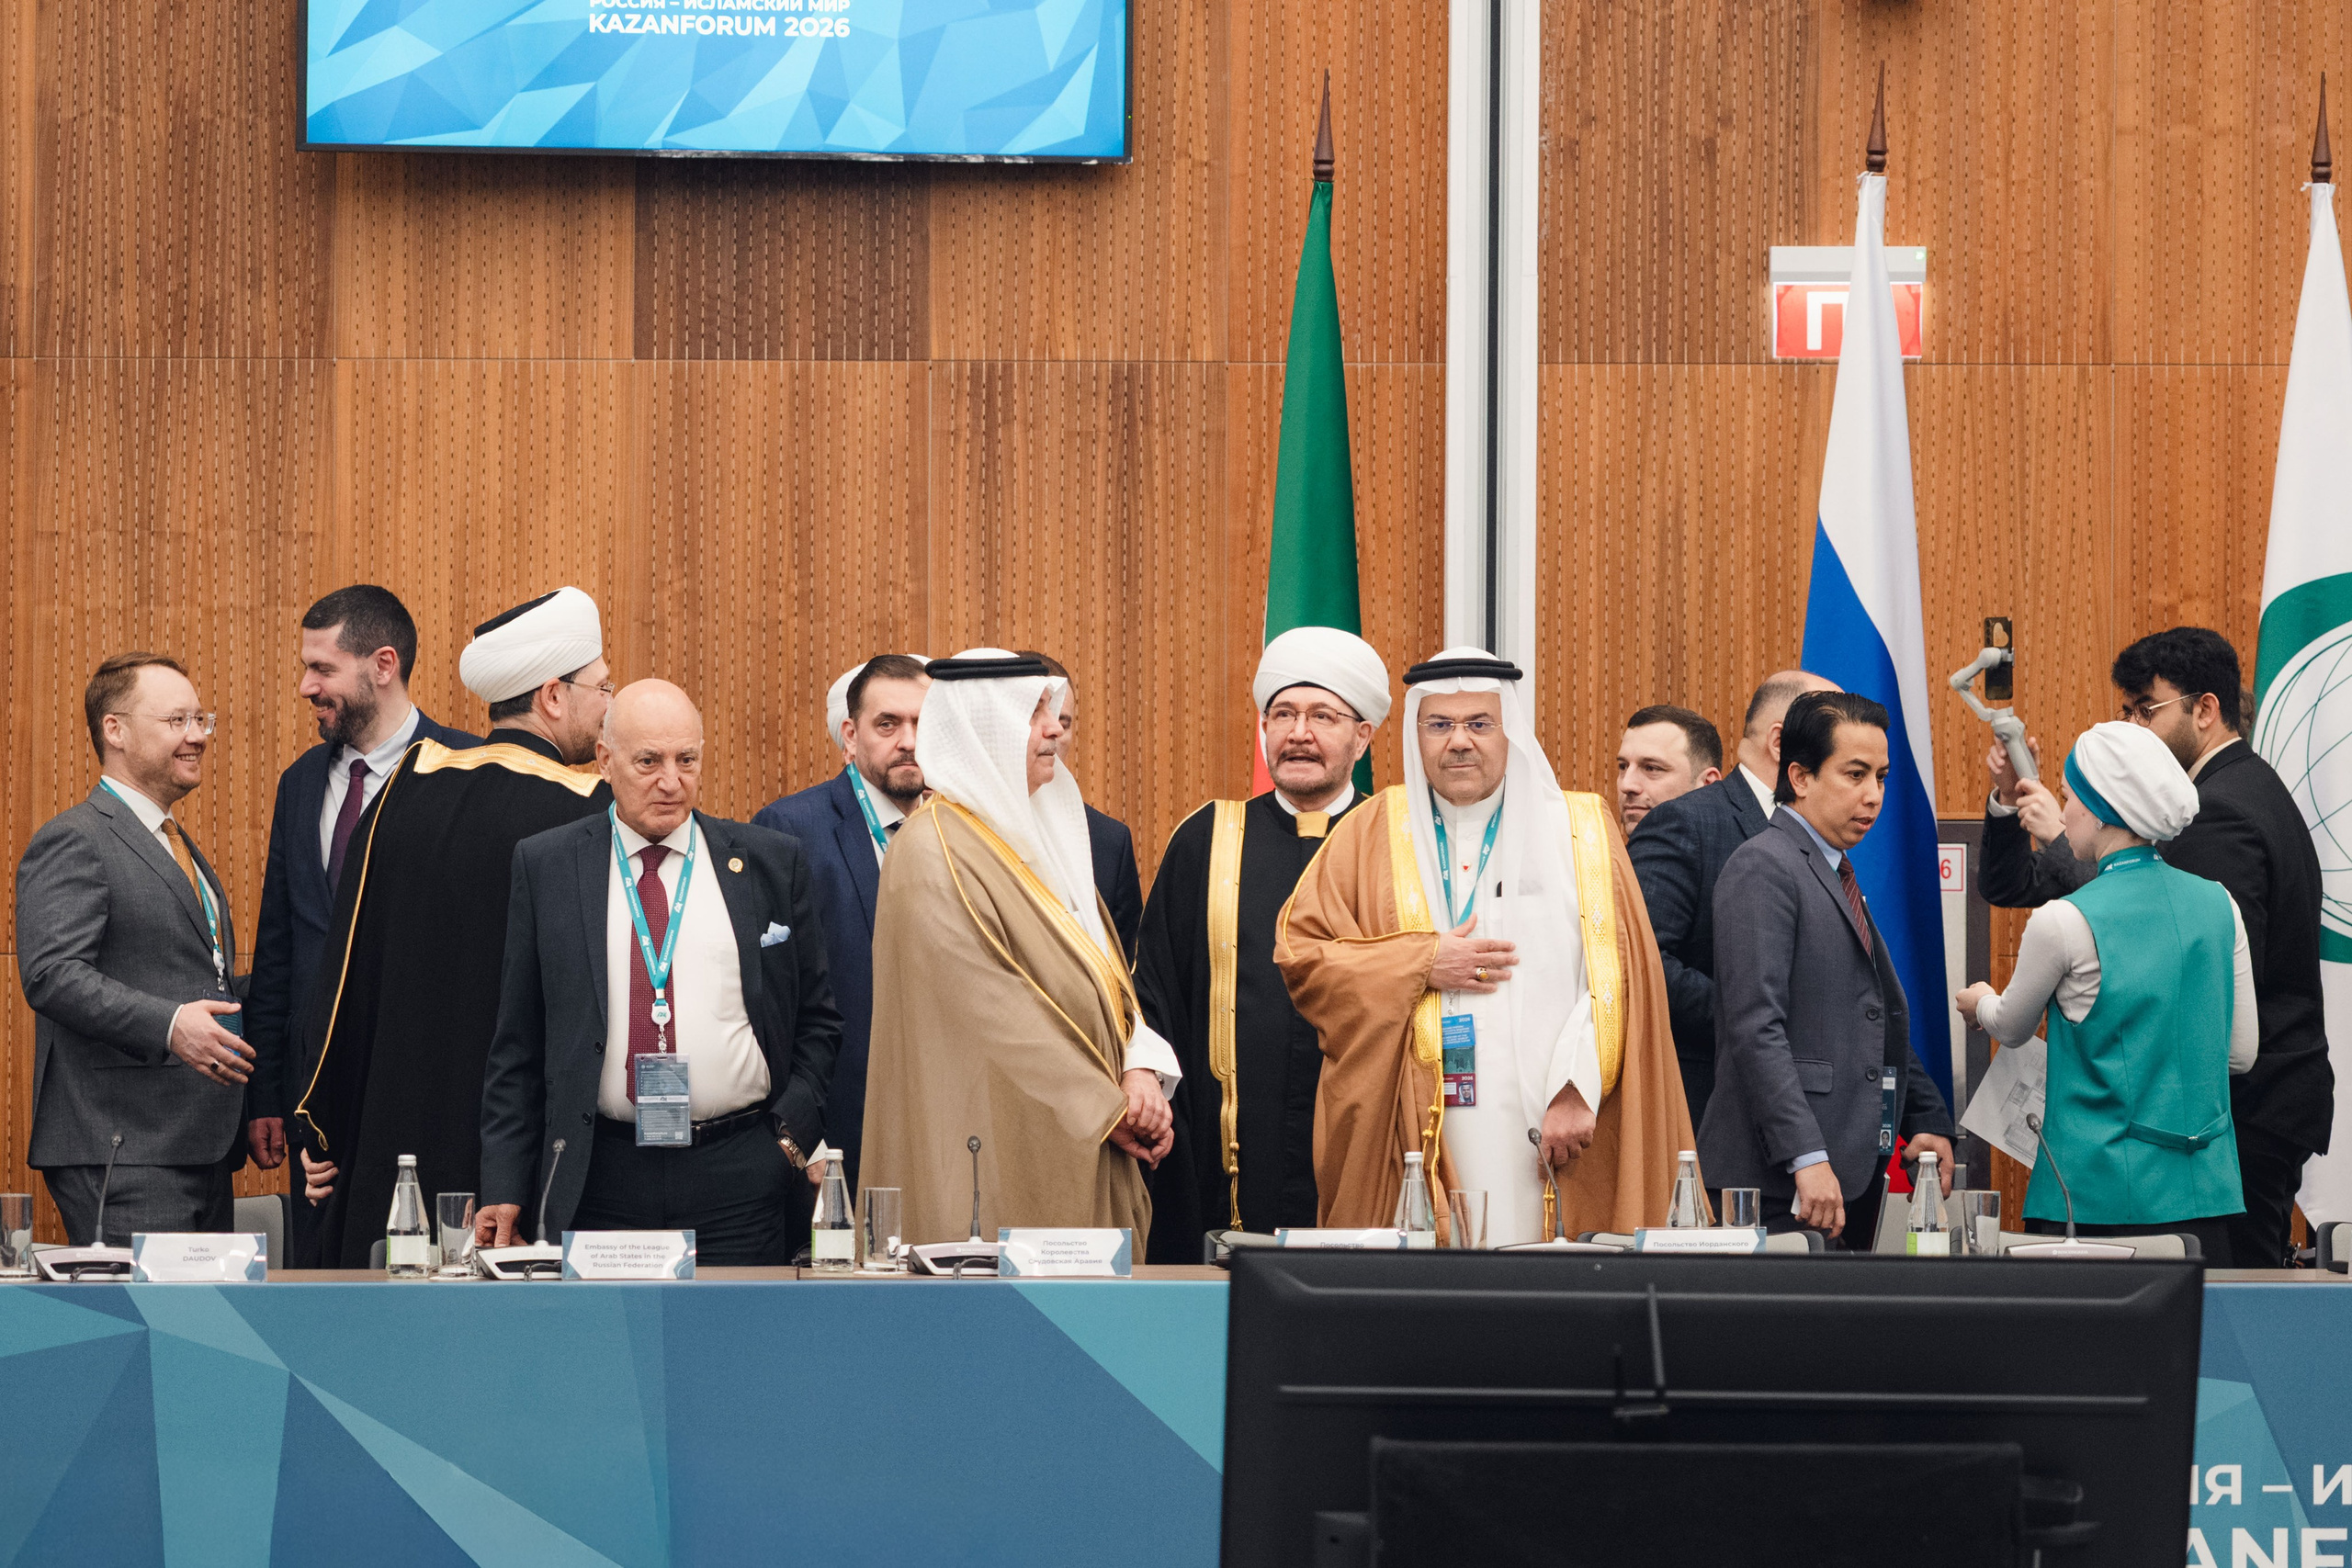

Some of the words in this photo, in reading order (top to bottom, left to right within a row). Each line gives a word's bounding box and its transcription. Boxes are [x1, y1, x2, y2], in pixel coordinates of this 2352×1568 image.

[808, 0, 851, 12] МИР
[589, 13, 775, 36] KAZANFORUM
[784, 17, 851, 38] 2026
[1940, 859, 1951, 879] 6
[2189, 1464, 2242, 1505] Я
